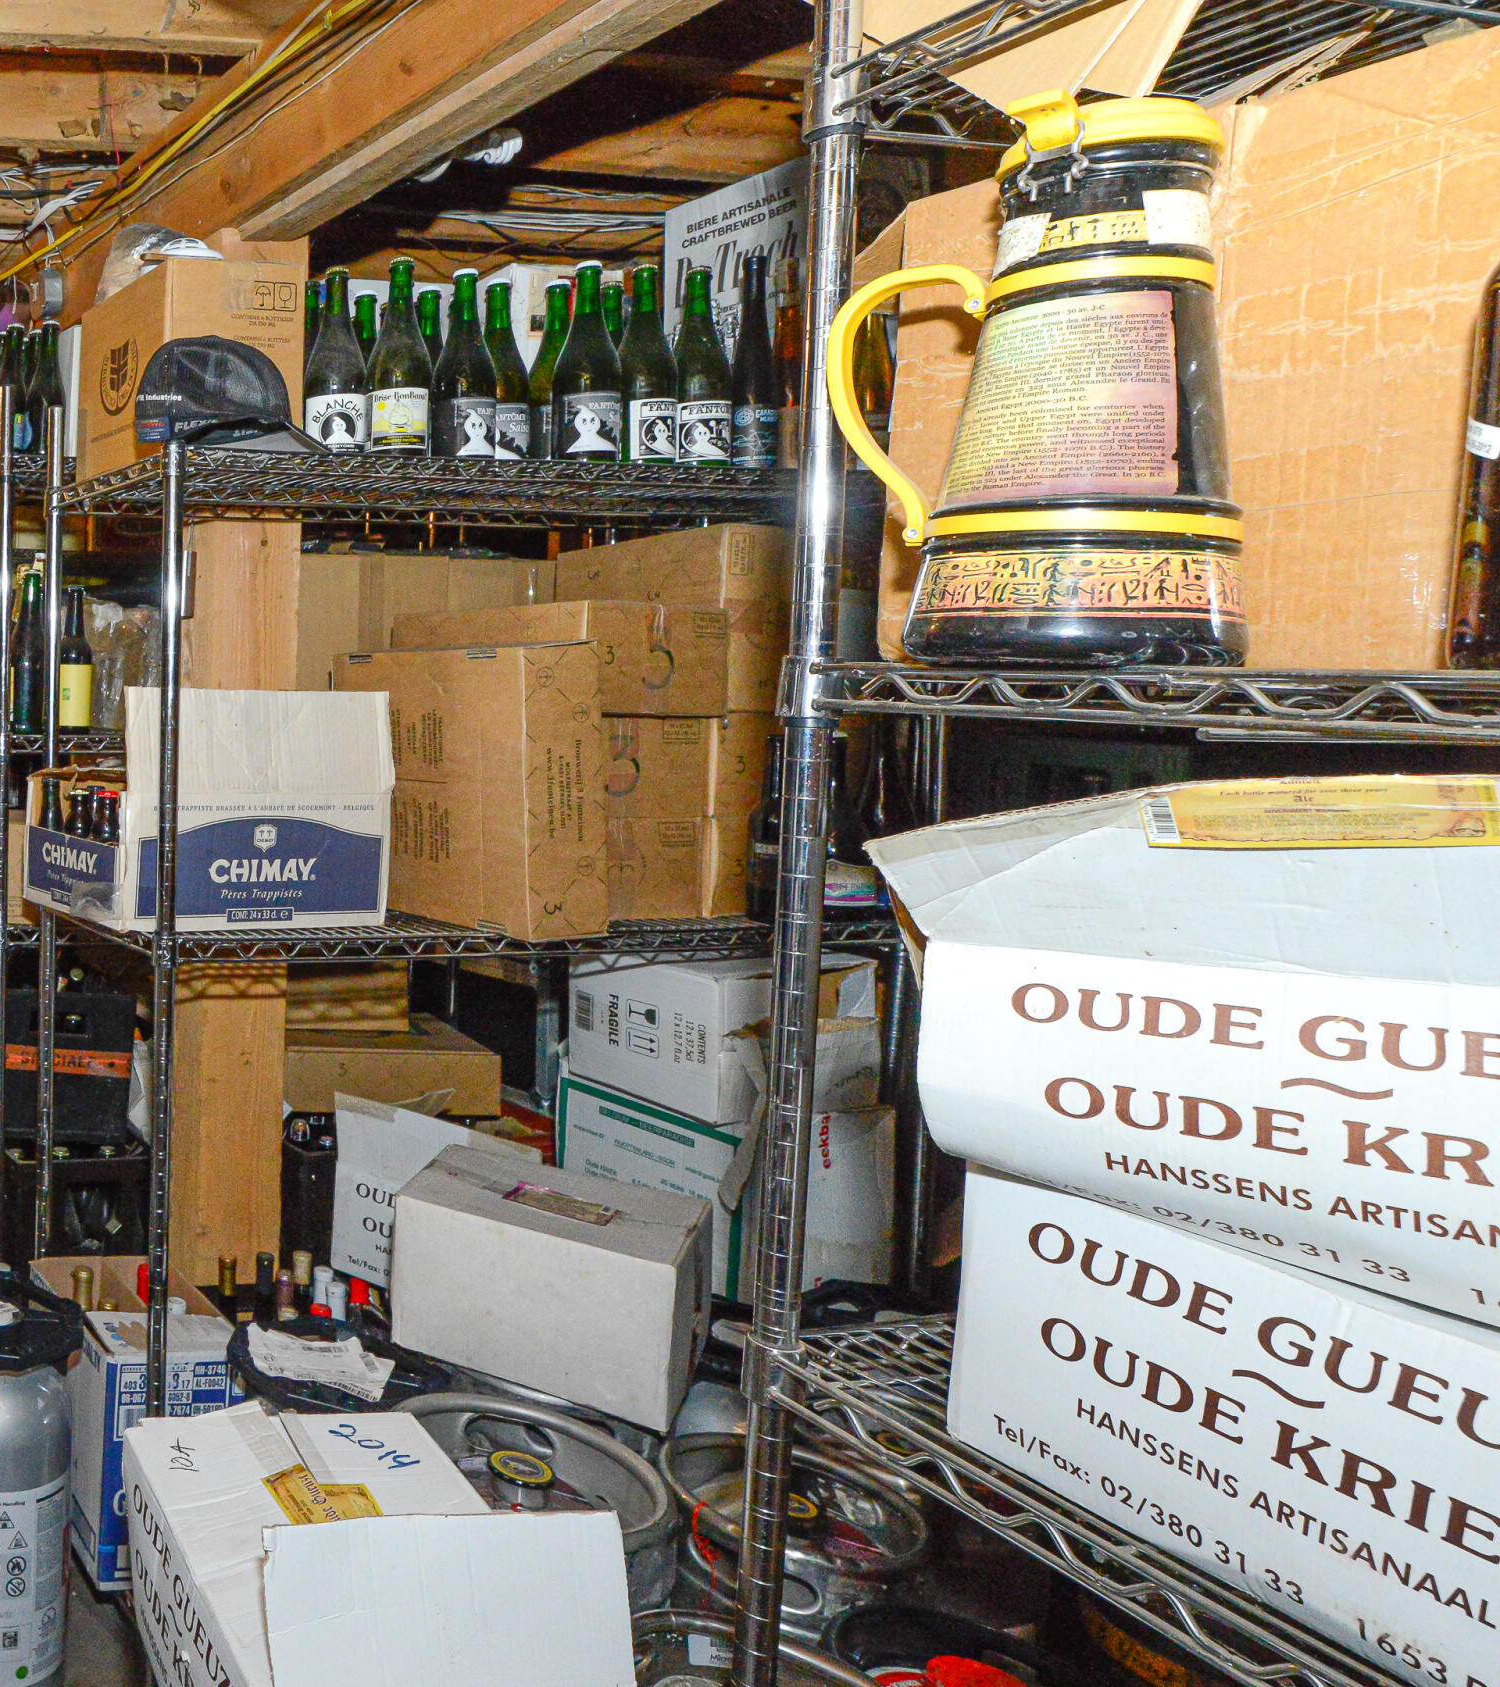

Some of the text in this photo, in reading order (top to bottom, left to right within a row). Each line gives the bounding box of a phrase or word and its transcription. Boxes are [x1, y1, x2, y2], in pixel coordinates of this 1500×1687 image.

[686, 186, 792, 234] BIERE ARTISANALE
[681, 199, 797, 249] CRAFTBREWED BEER
[1095, 370, 1132, 378] Pharaon
[1110, 363, 1171, 371] Nouvel Empire
[1070, 377, 1117, 386] Alexandre
[145, 392, 182, 402] Industries
[311, 398, 364, 424] BLANCHE
[1050, 412, 1076, 421] Egypt
[1106, 409, 1139, 417] unified
[1095, 417, 1165, 425] Egypt developed
[1118, 437, 1165, 445] exceptional
[1135, 430, 1166, 438] periods
[1040, 459, 1073, 467] Empire
[1060, 451, 1096, 459] Empire
[1024, 472, 1070, 481] Alexander
[1086, 464, 1126, 472] glorious
[252, 887, 304, 902] Trappistes
[608, 993, 619, 1048] FRAGILE
[1011, 983, 1264, 1050] OUDE
[697, 1023, 706, 1065] CONTENTS
[1044, 1076, 1308, 1157] OUDE
[1104, 1151, 1316, 1212] HANSSENS
[1152, 1204, 1412, 1284] 02/380 31 33
[347, 1254, 381, 1274] Tel/Fax:
[1027, 1221, 1235, 1336] OUDE
[123, 1381, 138, 1391] 403
[181, 1380, 191, 1390] 17
[1040, 1317, 1246, 1446] OUDE
[328, 1423, 421, 1470] 2014
[1075, 1398, 1500, 1630] HANSSENS ARTISANAAL
[132, 1484, 172, 1580] OUDE
[992, 1413, 1449, 1685] Tel/Fax: 02/380 31 33 1653
[135, 1548, 170, 1651] OUDE
